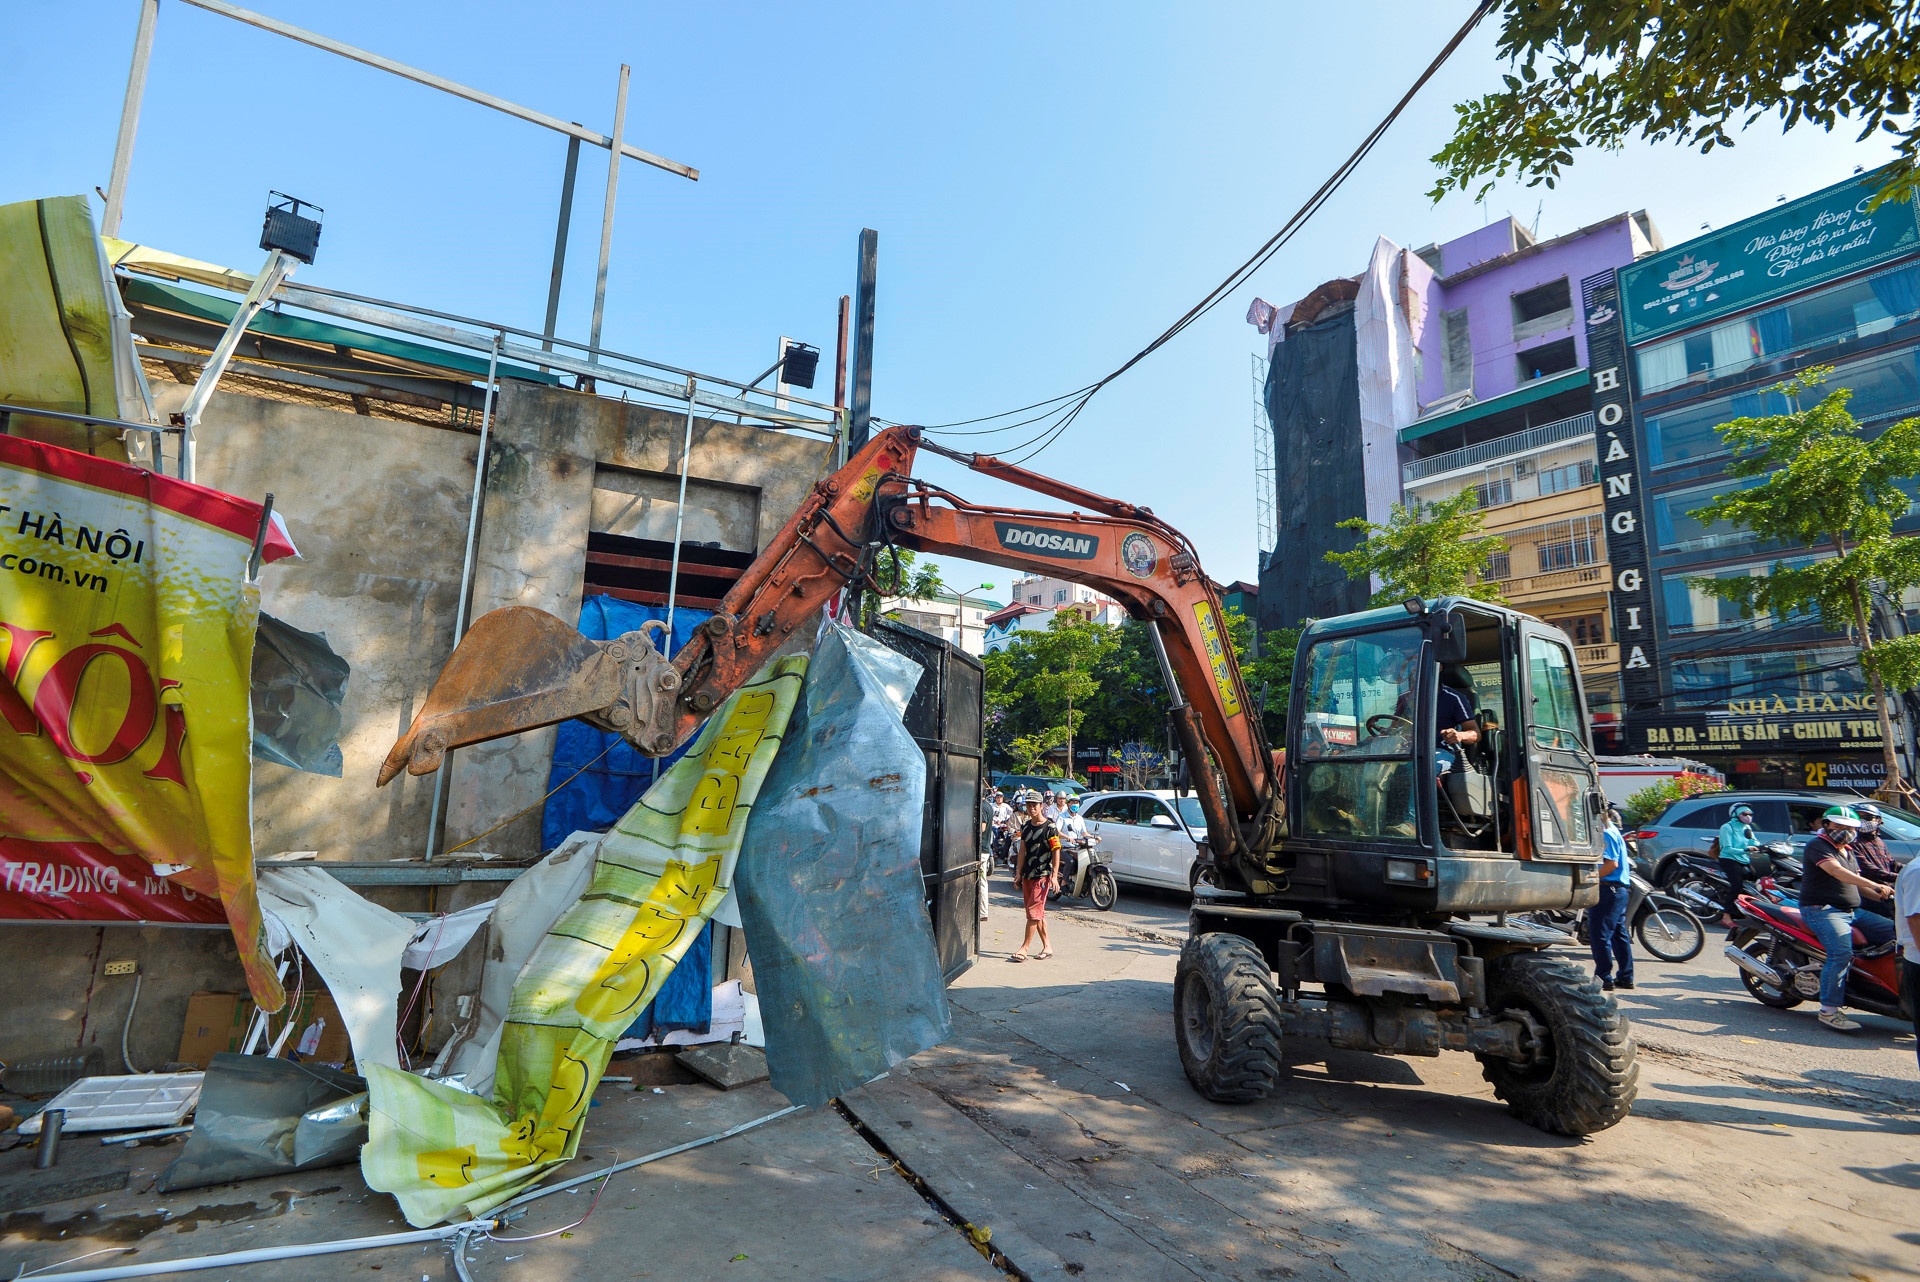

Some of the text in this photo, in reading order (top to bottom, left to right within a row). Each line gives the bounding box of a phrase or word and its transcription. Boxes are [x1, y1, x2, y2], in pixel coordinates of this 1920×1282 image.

[1778, 225, 1808, 244] hàng
[1811, 209, 1852, 231] Hoàng
[1828, 228, 1845, 242] xa
[1848, 218, 1872, 233] hoa
[1801, 249, 1825, 266] nhà
[1593, 367, 1636, 534] HOÀNG
[1618, 568, 1651, 669] GIA
[18, 510, 145, 565] HÀ NỘI
[1004, 528, 1091, 554] DOOSAN
[1728, 692, 1878, 716] NHÀ HÀNG
[1647, 728, 1670, 743] BA
[1673, 727, 1697, 743] BA
[1707, 719, 1739, 742] HẢI
[1742, 717, 1780, 741] SẢN
[1792, 721, 1843, 739] CHIM
[1804, 762, 1828, 787] 2F
[1828, 760, 1888, 775] HOÀNG GI
[1853, 777, 1877, 788] KHÁNH
[5, 861, 120, 896] TRADING
